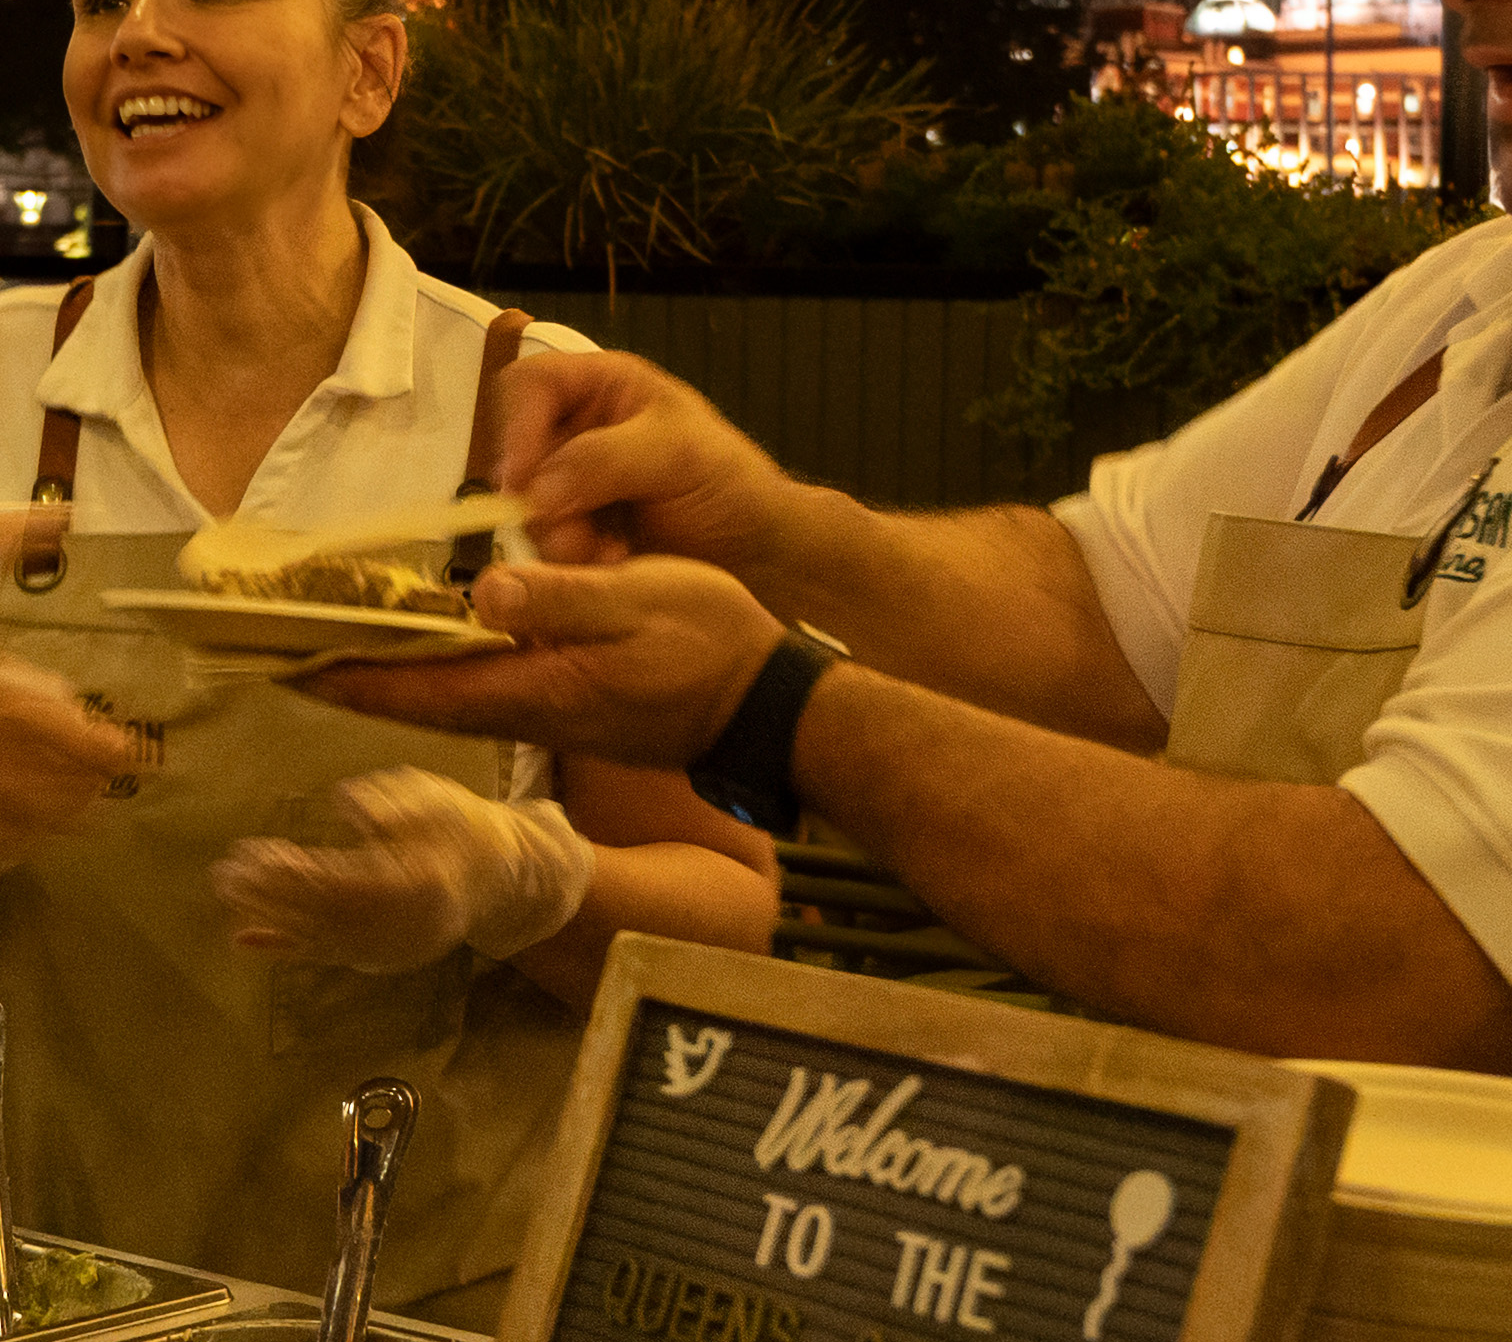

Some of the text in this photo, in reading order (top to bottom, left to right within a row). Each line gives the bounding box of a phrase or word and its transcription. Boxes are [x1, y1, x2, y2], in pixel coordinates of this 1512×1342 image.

[753, 1065, 1025, 1218] Welcome
[754, 1192, 1013, 1333] TO THE
